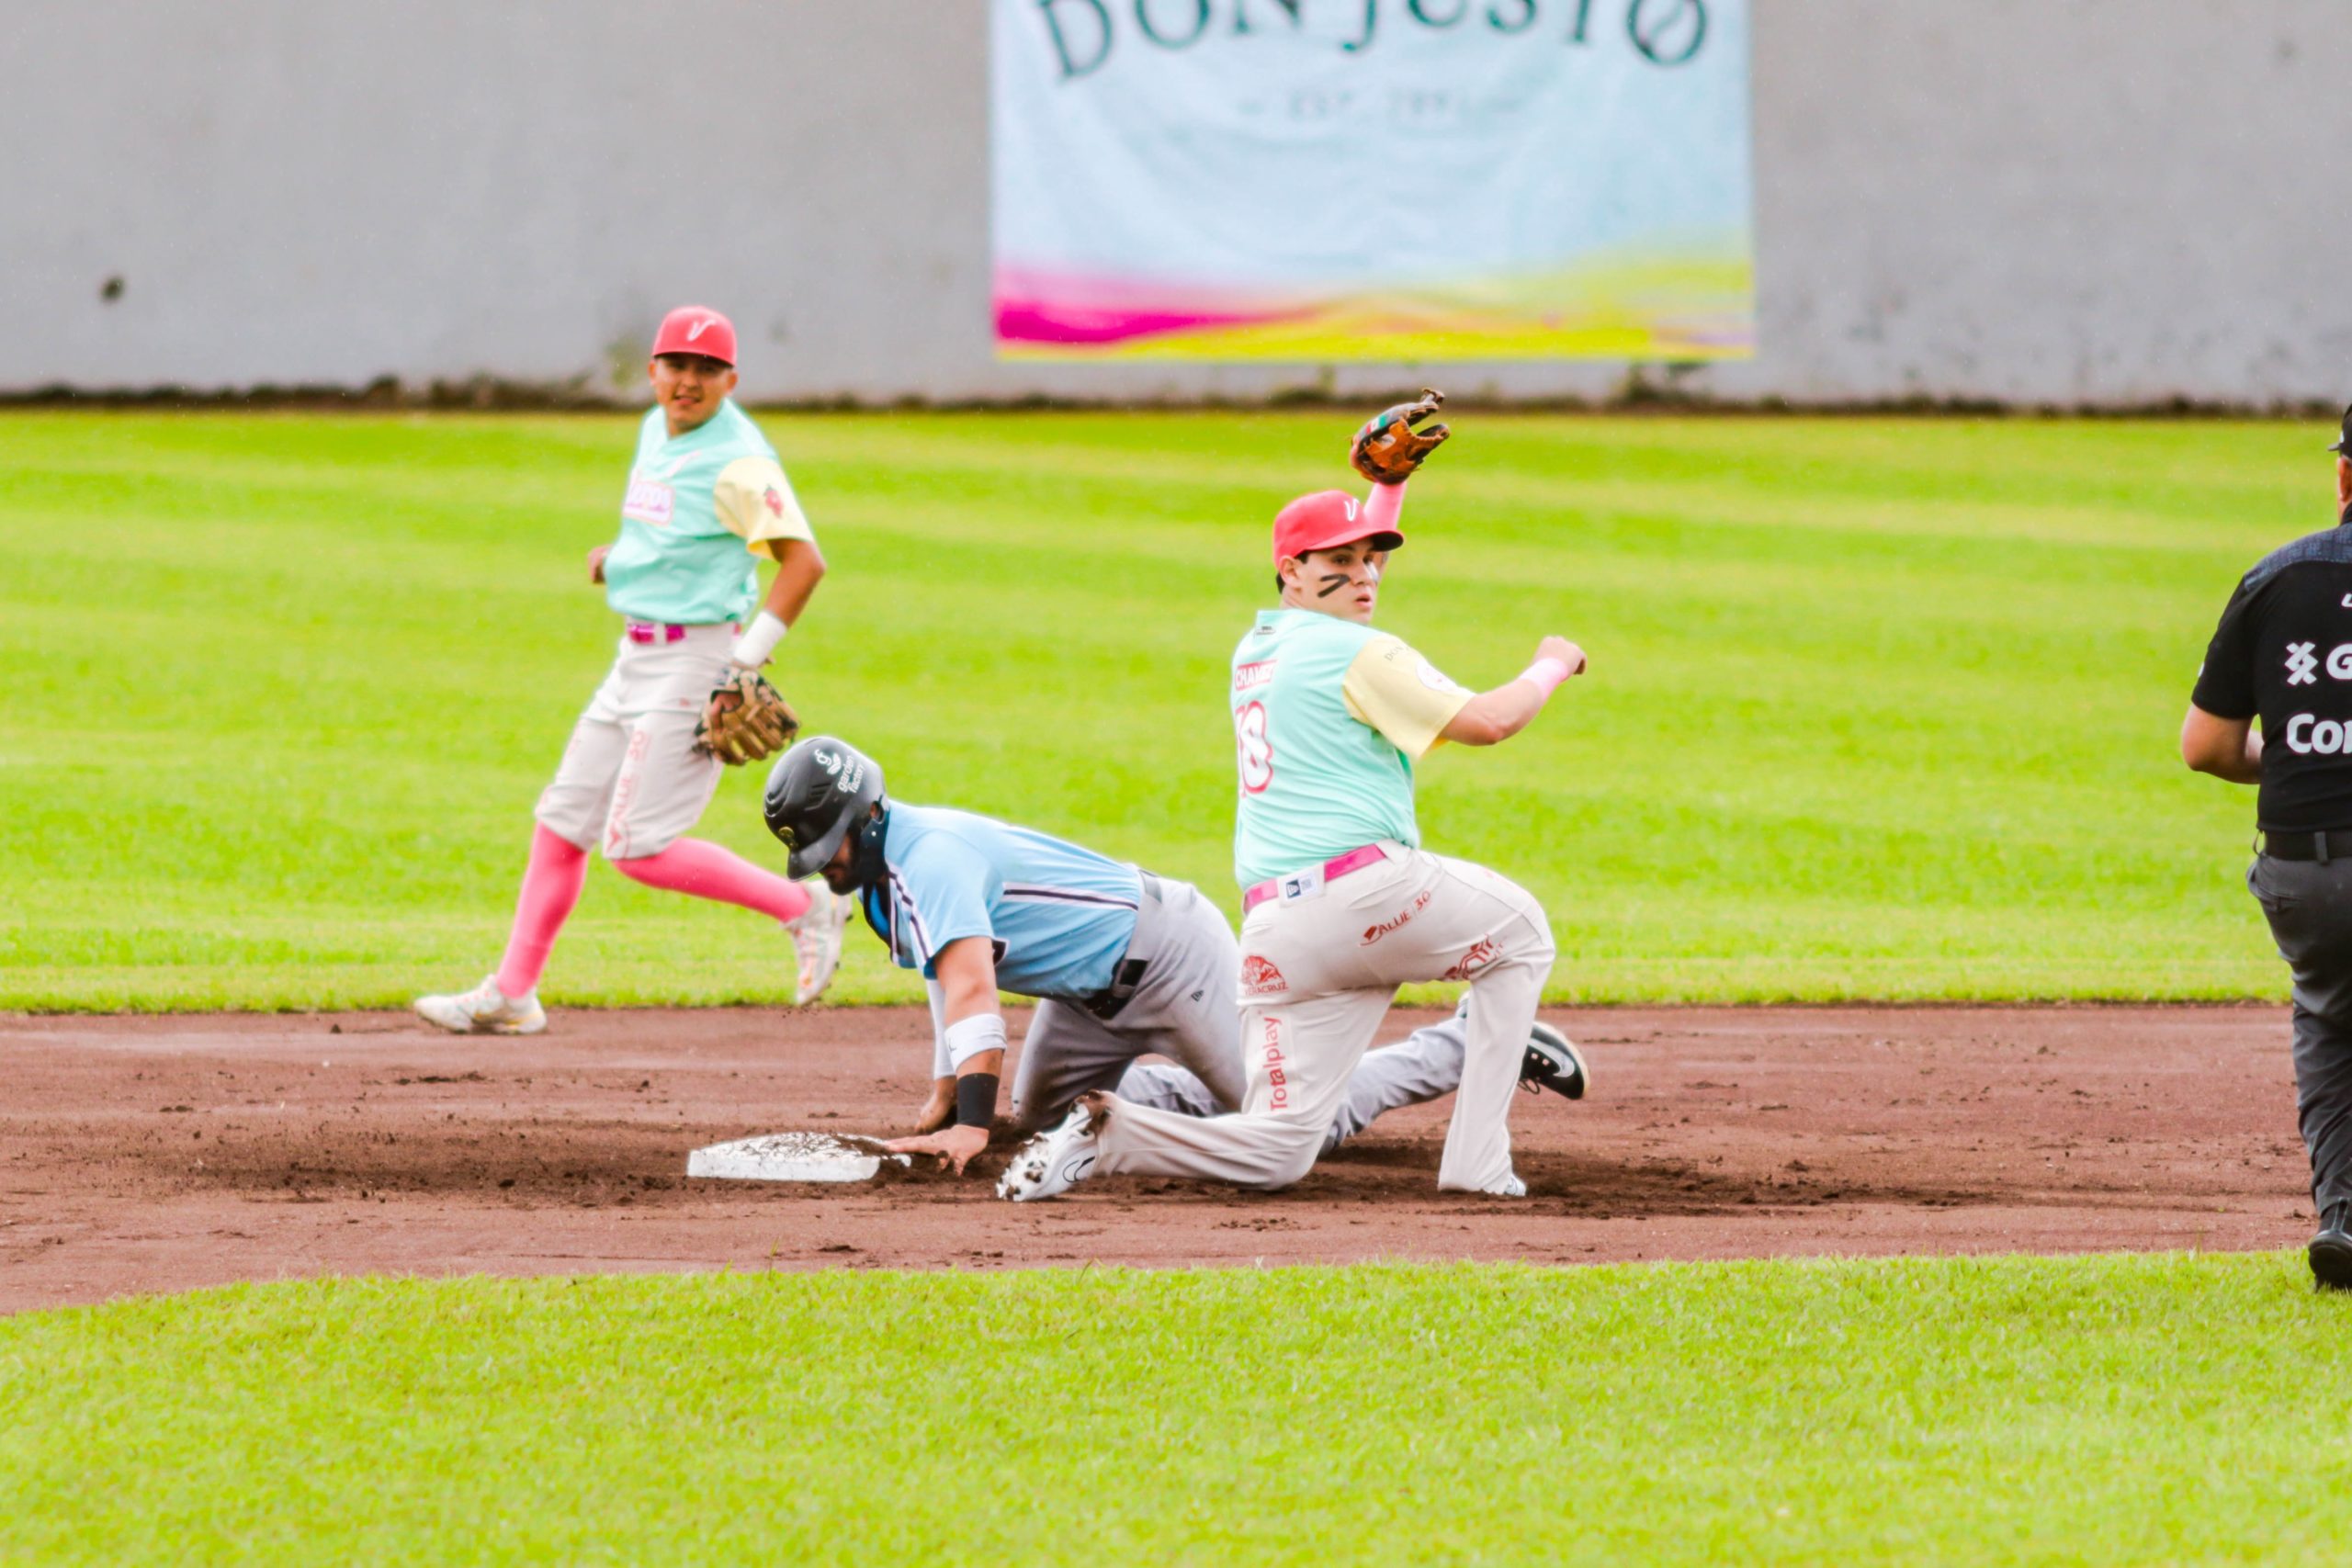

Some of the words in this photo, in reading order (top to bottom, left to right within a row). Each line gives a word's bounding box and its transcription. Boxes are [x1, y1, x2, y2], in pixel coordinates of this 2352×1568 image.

[837, 755, 854, 794] garden
[847, 764, 865, 794] factory
[1262, 1016, 1288, 1111] Totalplay
